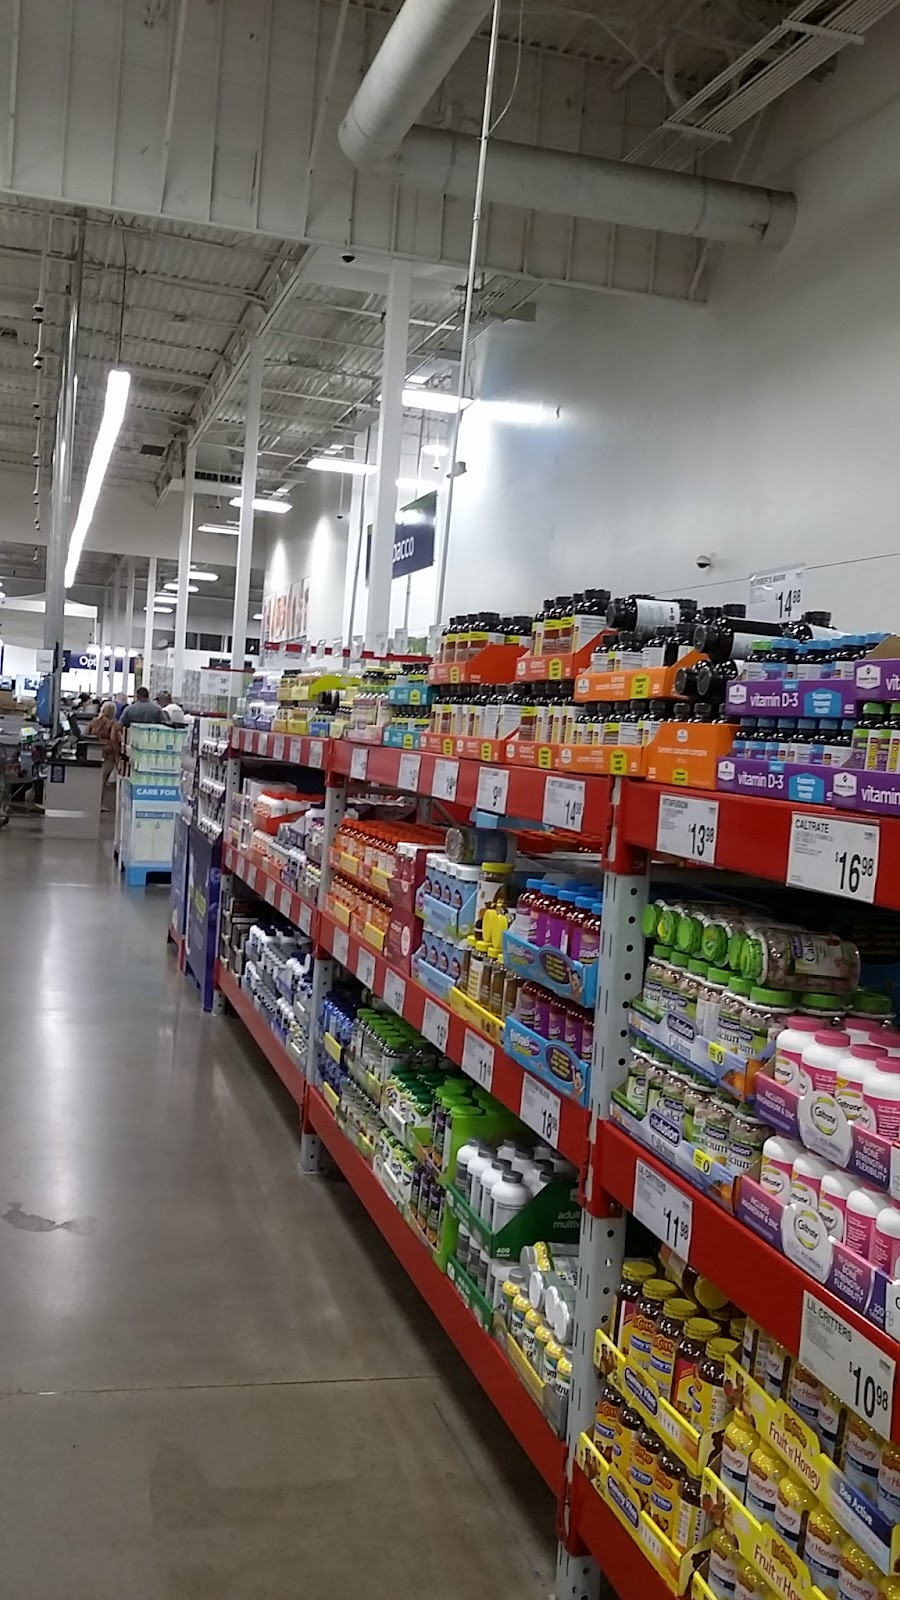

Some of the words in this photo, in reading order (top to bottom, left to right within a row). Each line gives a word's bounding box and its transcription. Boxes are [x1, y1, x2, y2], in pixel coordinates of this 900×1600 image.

[392, 536, 415, 563] acco
[750, 692, 781, 707] vitamin
[781, 692, 799, 708] D-3
[738, 771, 766, 788] vitamin
[767, 773, 784, 789] D-3
[136, 788, 159, 796] CARE
[795, 818, 830, 834] CALTRATE
[814, 1105, 836, 1125] Caltrate
[863, 1145, 879, 1160] BONE
[798, 1219, 819, 1240] Caltrate
[842, 1263, 857, 1282] BONE
[834, 1277, 863, 1304] FLEXIBILITY
[818, 1307, 853, 1342] CRITTERS
[769, 1420, 789, 1454] Fruit
[794, 1447, 820, 1491] Honey
[851, 1497, 873, 1526] Active
[754, 1543, 776, 1580] Fruit
